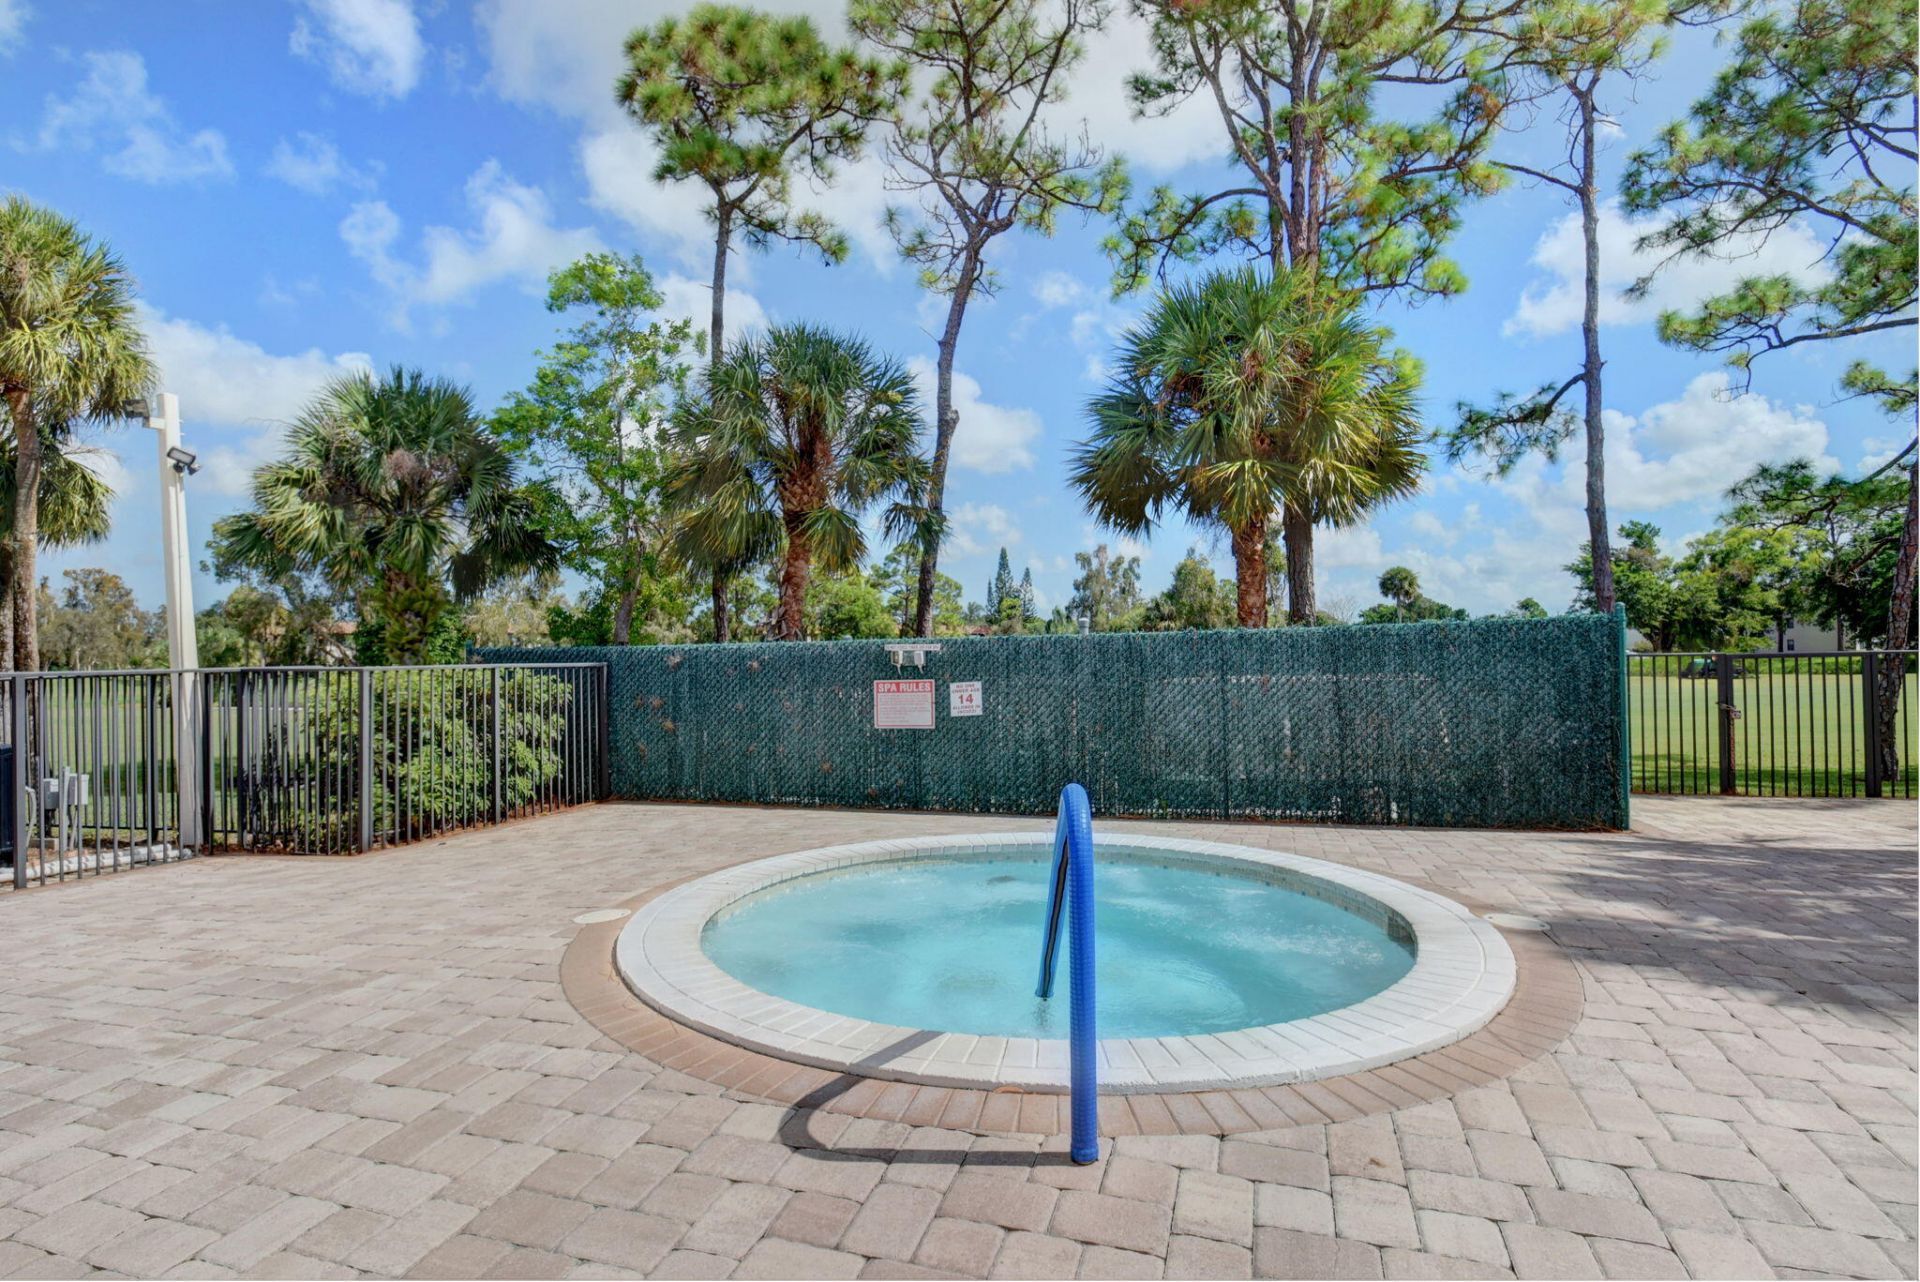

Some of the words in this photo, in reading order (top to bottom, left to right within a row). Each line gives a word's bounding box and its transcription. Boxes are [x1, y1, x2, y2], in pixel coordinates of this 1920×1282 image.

[878, 683, 897, 692] SPA
[899, 682, 931, 691] RULES
[959, 694, 973, 704] 14
